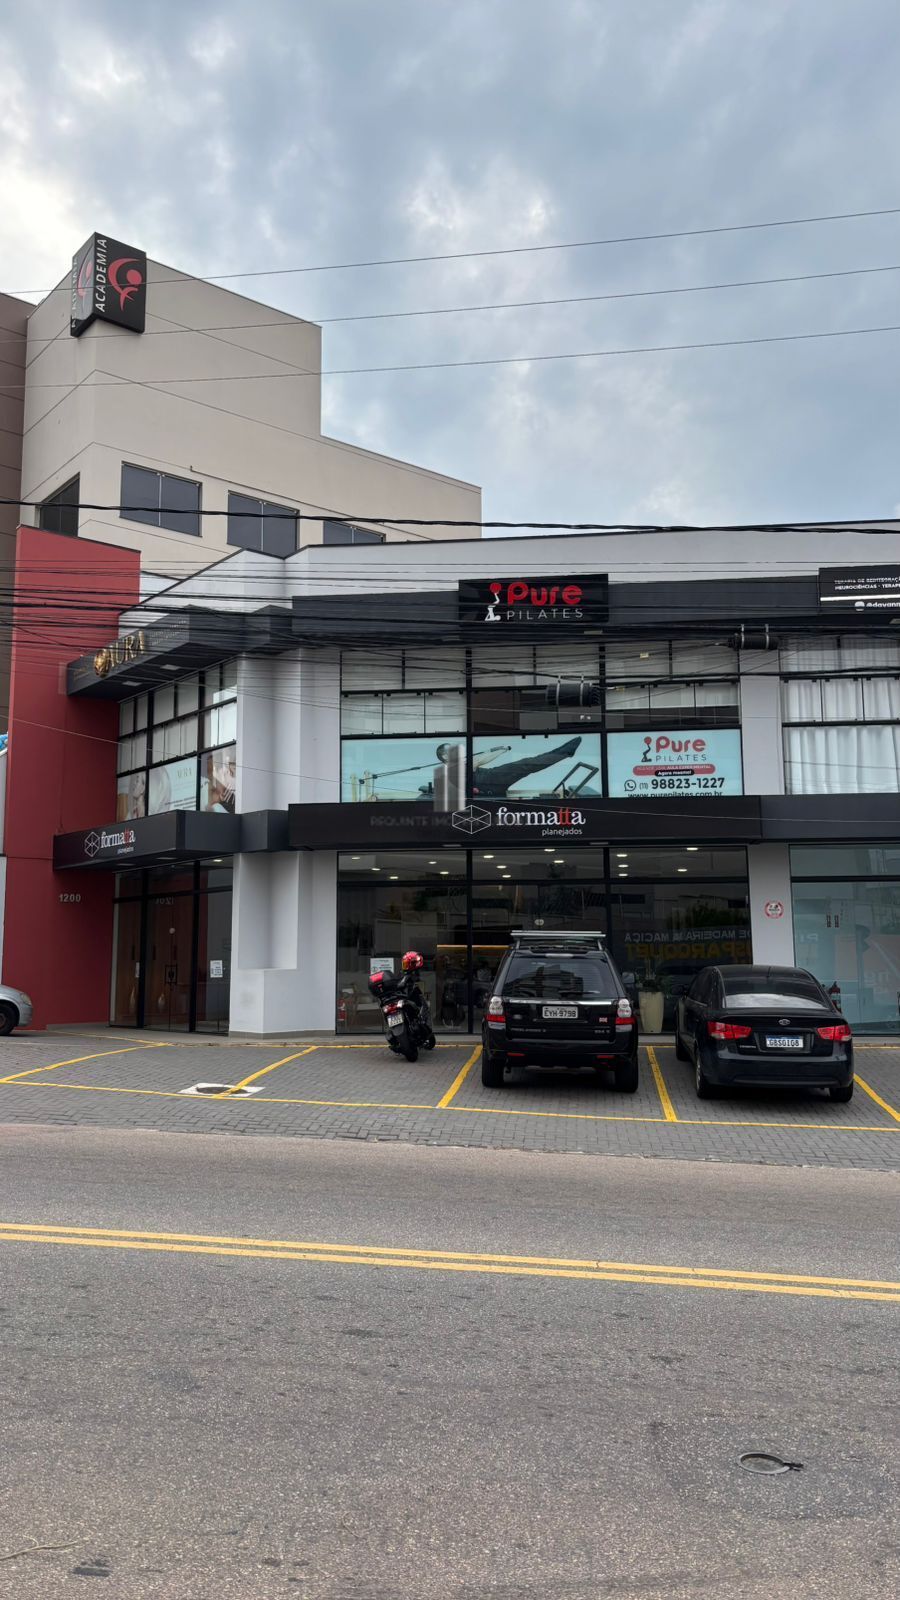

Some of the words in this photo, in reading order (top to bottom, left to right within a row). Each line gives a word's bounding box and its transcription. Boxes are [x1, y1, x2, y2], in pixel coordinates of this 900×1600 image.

[95, 239, 107, 313] ACADEMIA
[507, 581, 583, 607] Pure
[506, 608, 584, 620] PILATES
[655, 735, 706, 753] Pure
[655, 753, 707, 762] PILATES
[651, 777, 725, 790] 98823-1227
[496, 806, 587, 826] formatta
[541, 827, 583, 836] planejados
[58, 893, 81, 903] 1200
